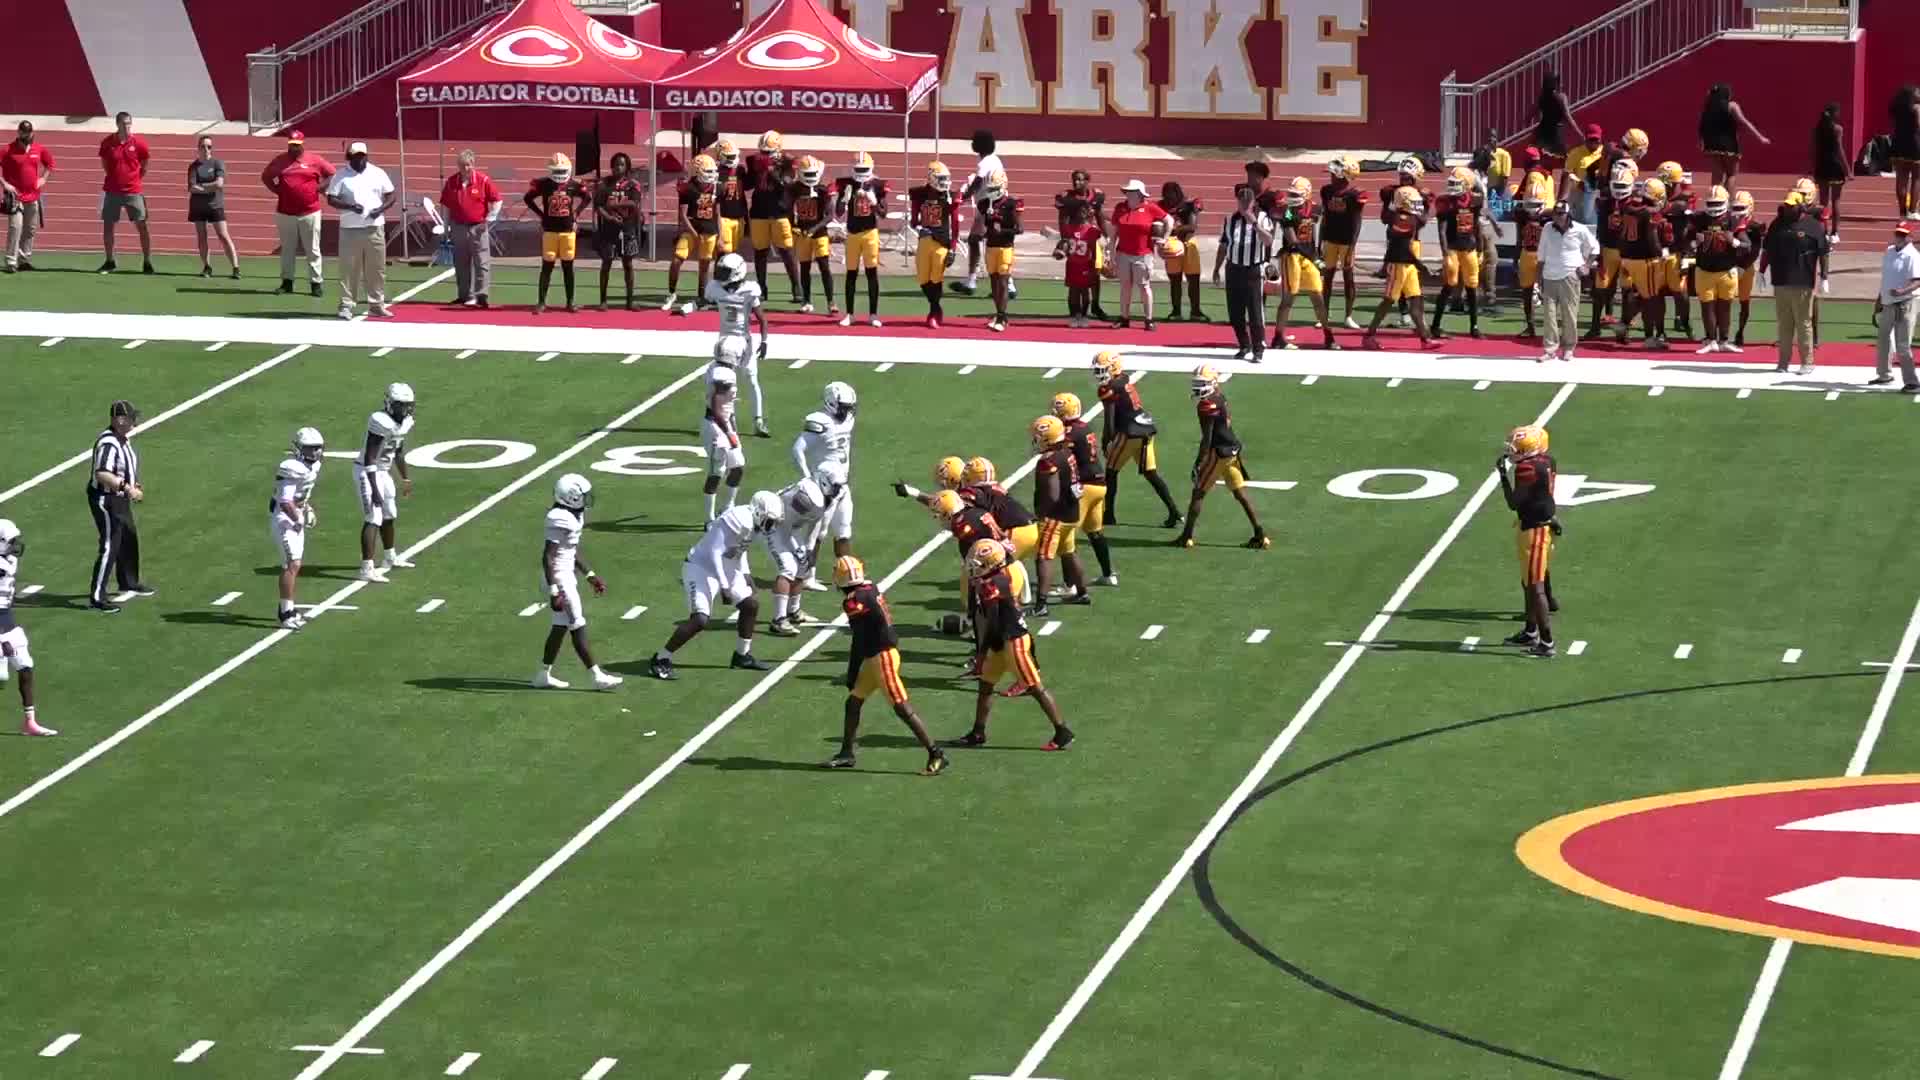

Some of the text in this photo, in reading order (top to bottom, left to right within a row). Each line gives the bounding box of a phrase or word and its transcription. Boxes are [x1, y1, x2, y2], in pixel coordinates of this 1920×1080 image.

[411, 84, 639, 105] GLADIATOR FOOTBALL
[666, 88, 894, 110] GLADIATOR FOOTBALL
